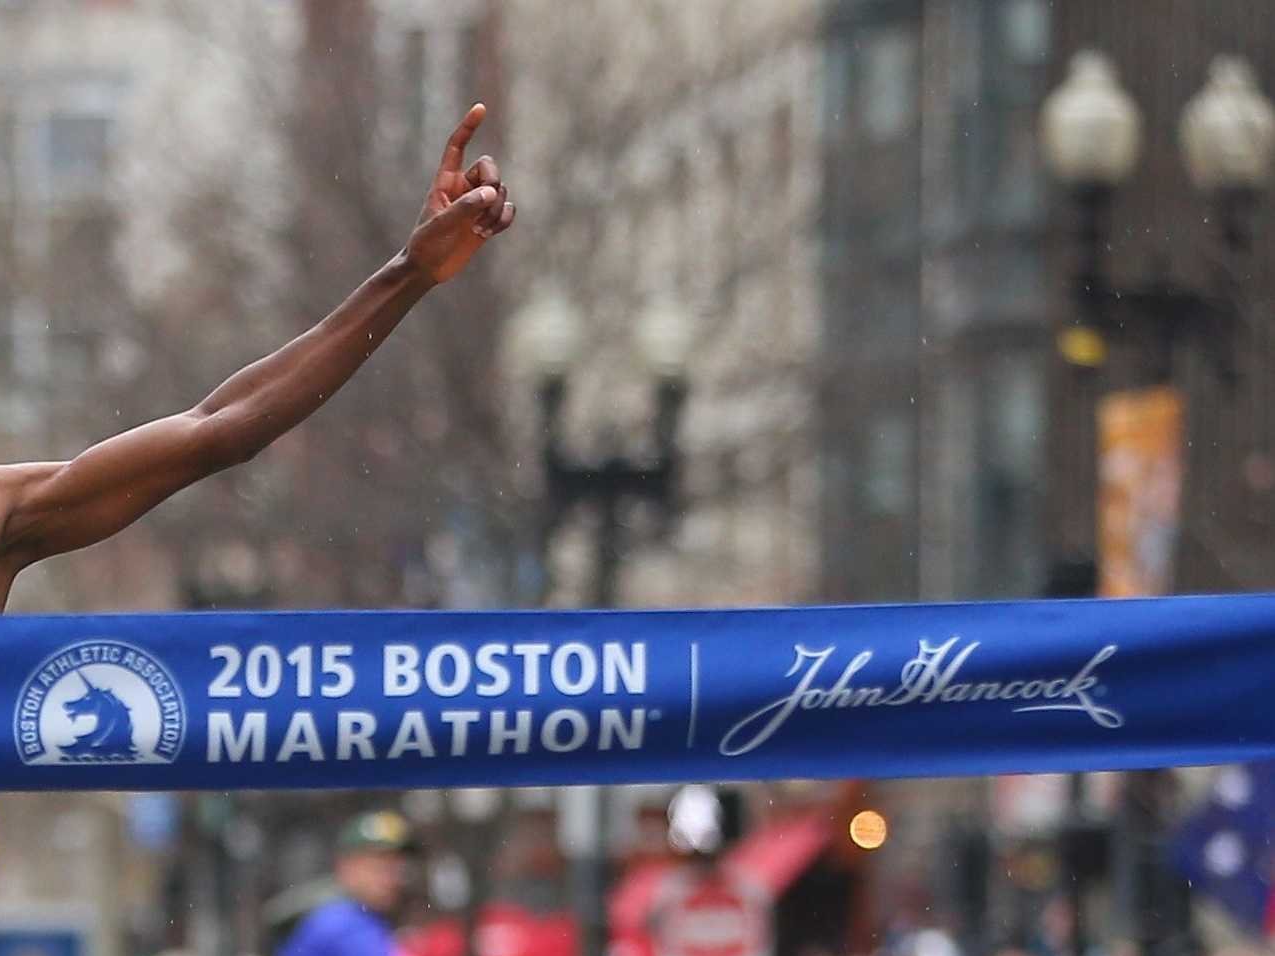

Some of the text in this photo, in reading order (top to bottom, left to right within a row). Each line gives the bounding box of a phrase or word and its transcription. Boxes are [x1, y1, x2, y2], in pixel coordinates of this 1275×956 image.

[21, 646, 180, 756] BOSTON ATHLETIC ASSOCIATION
[208, 642, 646, 698] 2015 BOSTON
[720, 635, 1124, 756] John Hancock
[208, 709, 645, 763] MARATHON
